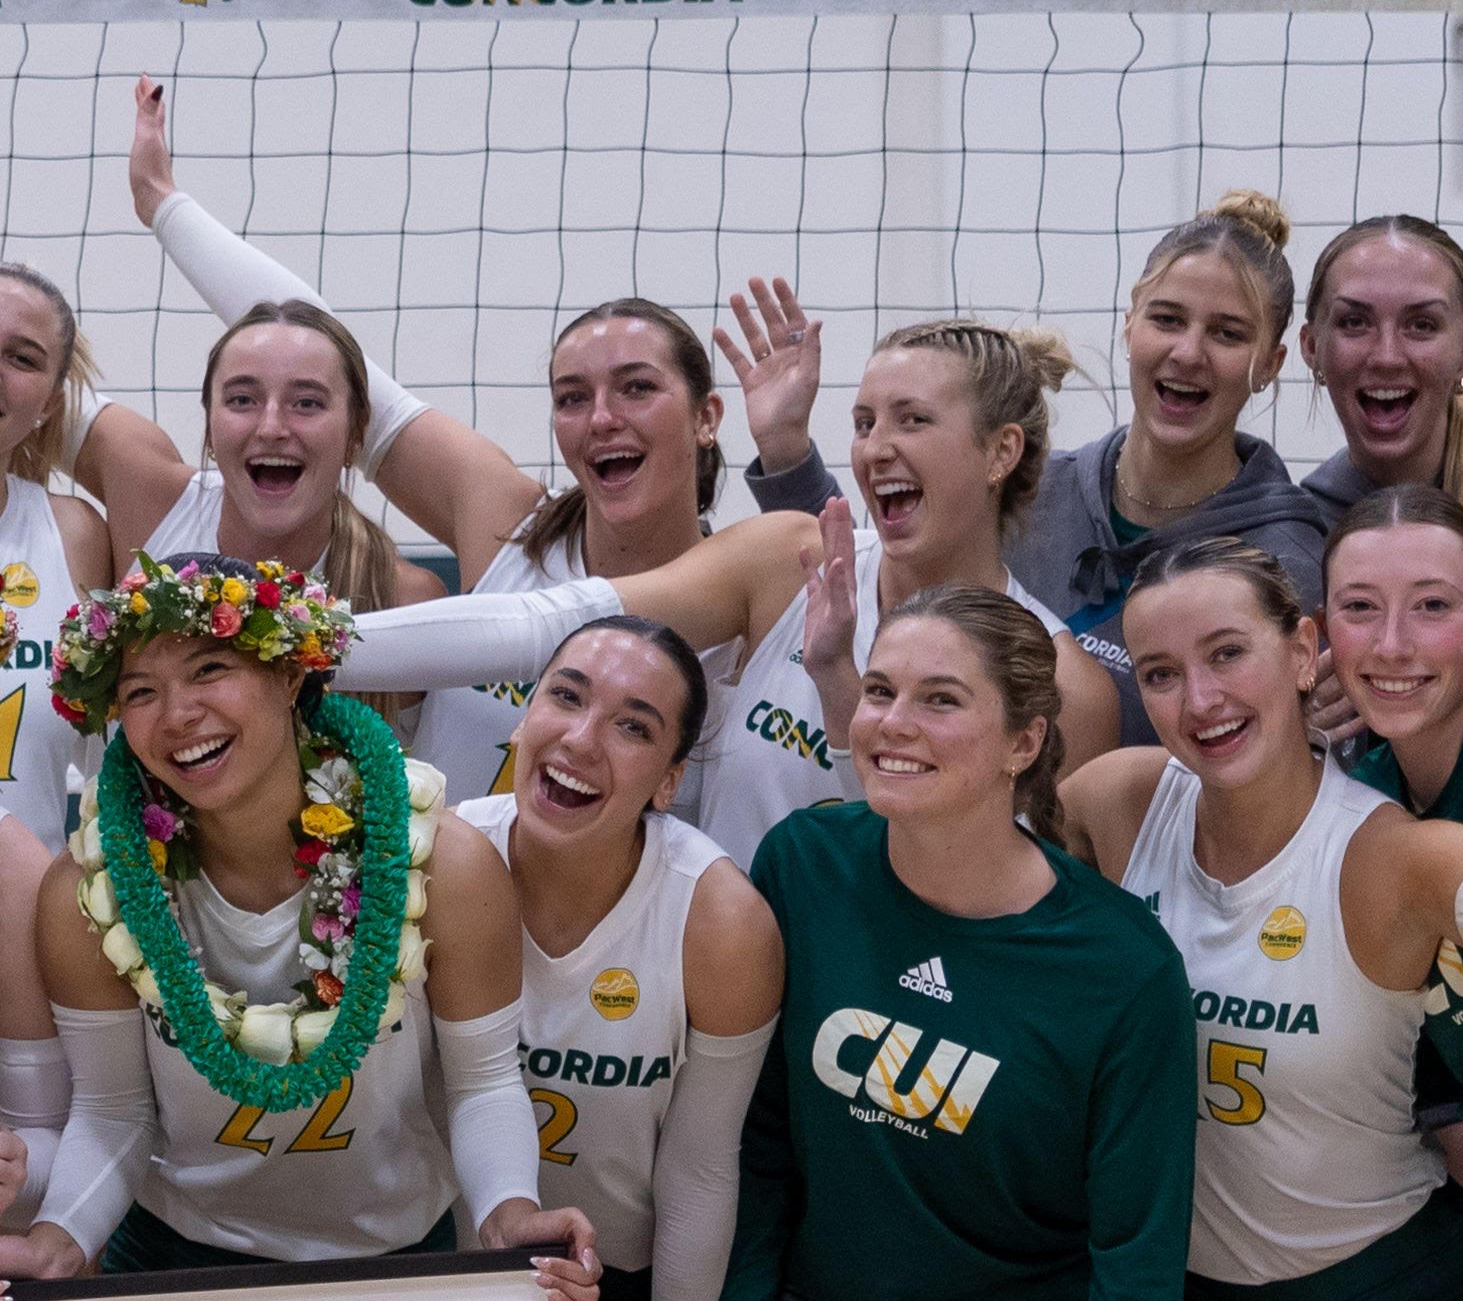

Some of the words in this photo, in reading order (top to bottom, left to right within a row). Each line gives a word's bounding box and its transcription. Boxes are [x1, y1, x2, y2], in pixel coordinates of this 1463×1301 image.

[1262, 932, 1302, 944] PacWest
[899, 974, 952, 1003] adidas
[812, 1008, 1000, 1135] CUI
[848, 1103, 929, 1140] VOLLEYBALL
